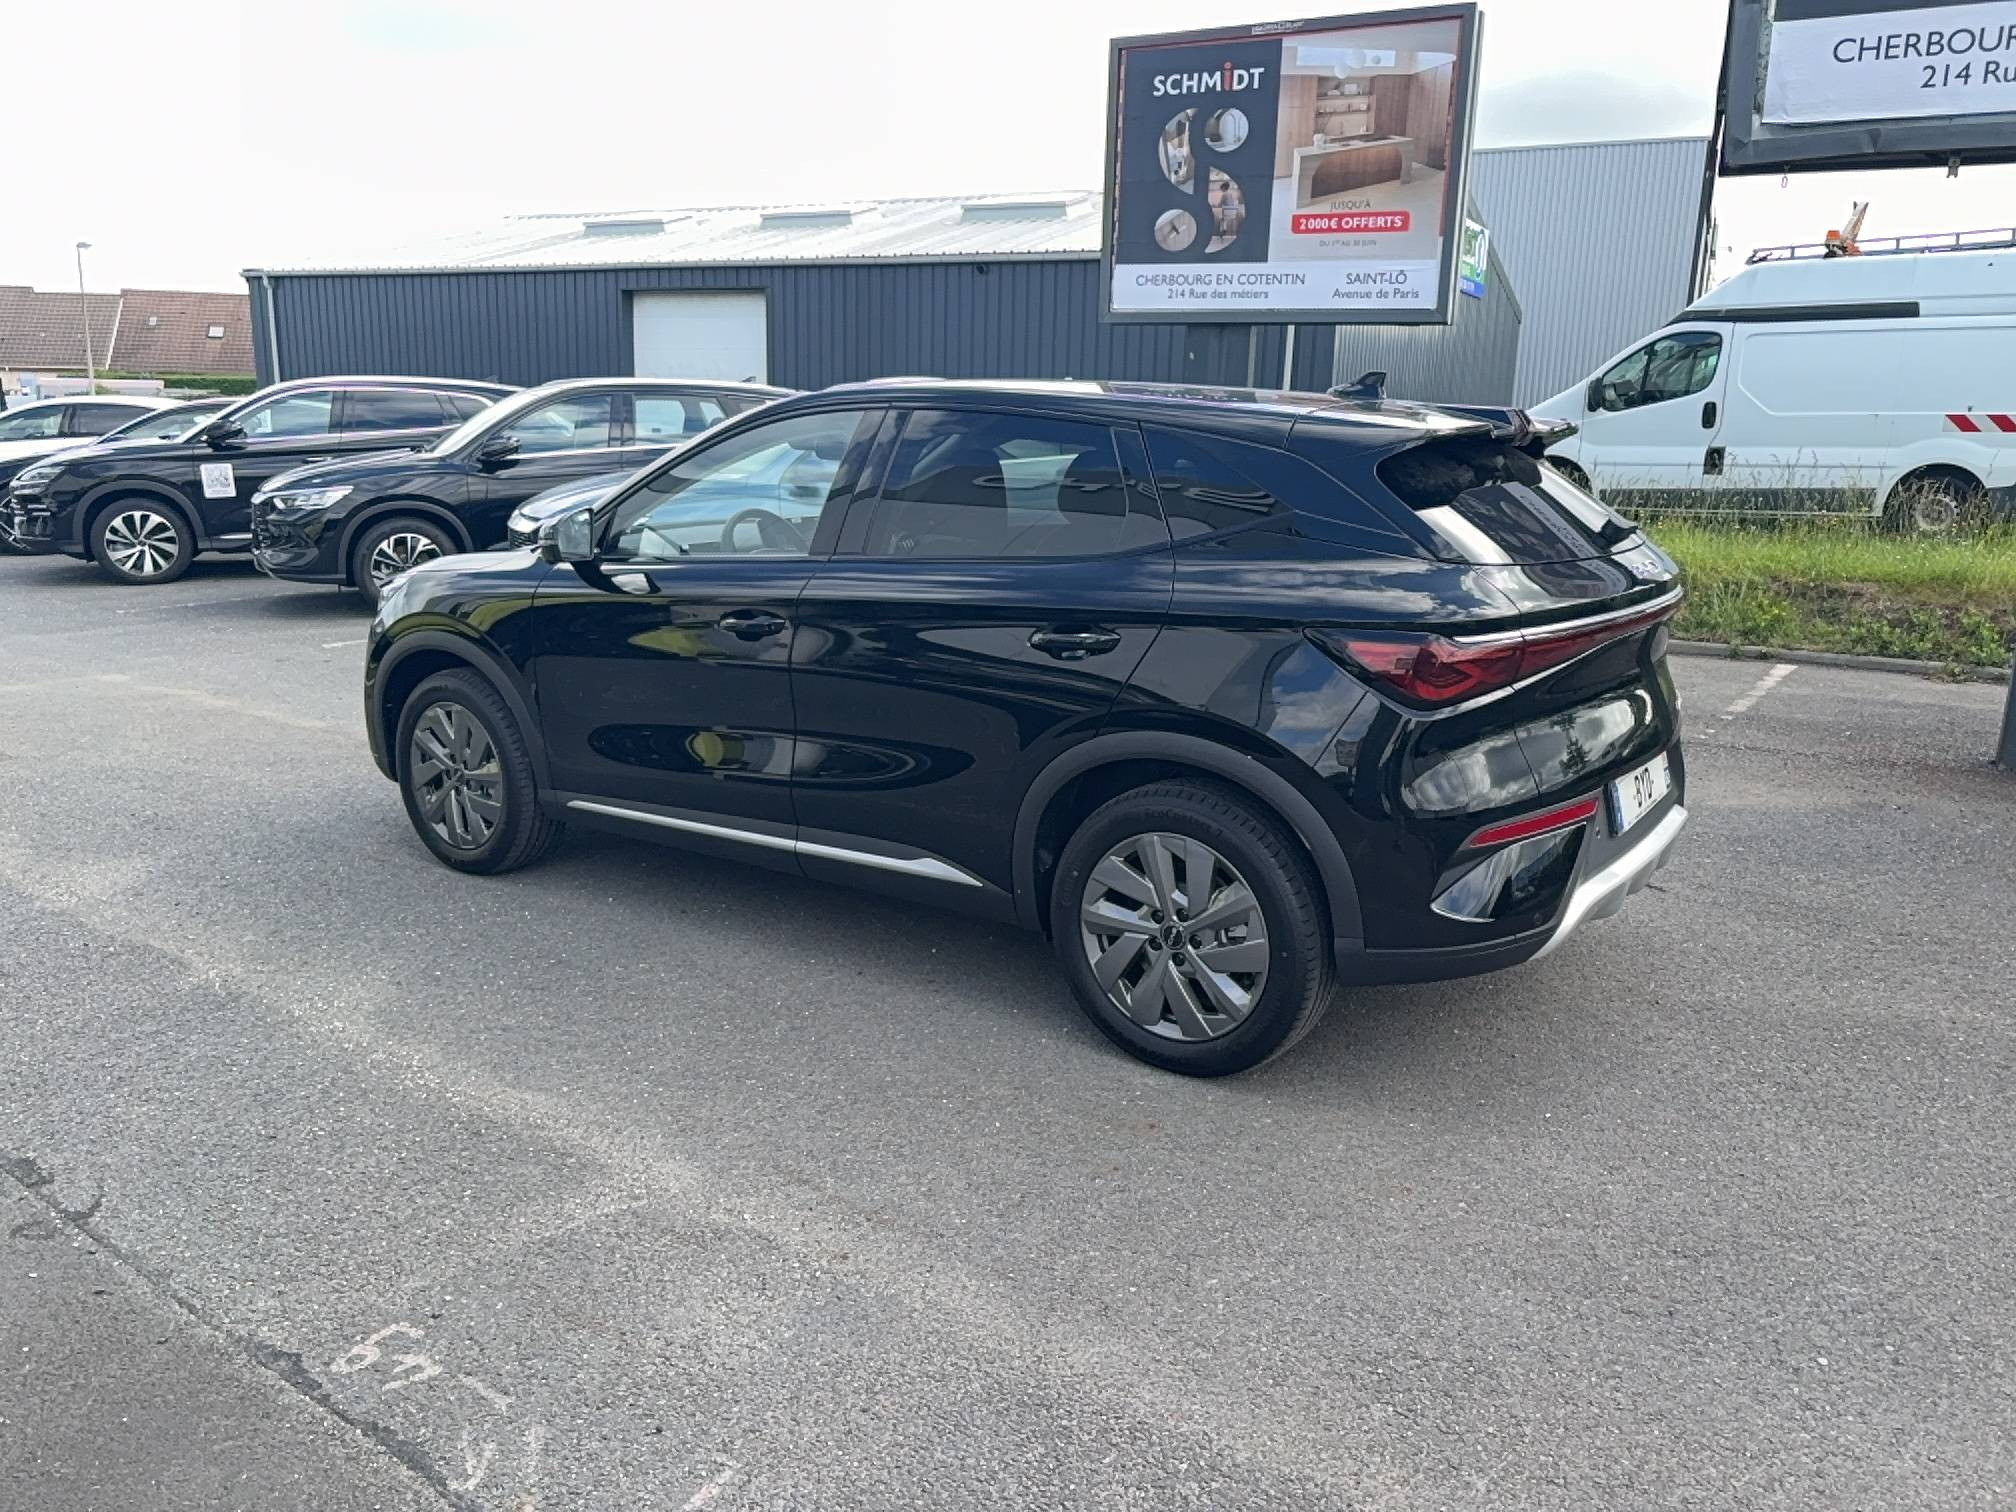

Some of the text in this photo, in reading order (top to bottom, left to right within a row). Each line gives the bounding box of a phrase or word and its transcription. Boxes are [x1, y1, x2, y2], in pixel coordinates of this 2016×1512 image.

[1833, 24, 2016, 63] CHERBOUR
[1920, 63, 1972, 90] 214
[1341, 215, 1404, 229] OFFERTS
[1135, 273, 1306, 287] CHERBOURG EN COTENTIN
[1167, 288, 1269, 299] 214 Rue des métiers
[1332, 288, 1420, 299] Avenue de Paris
